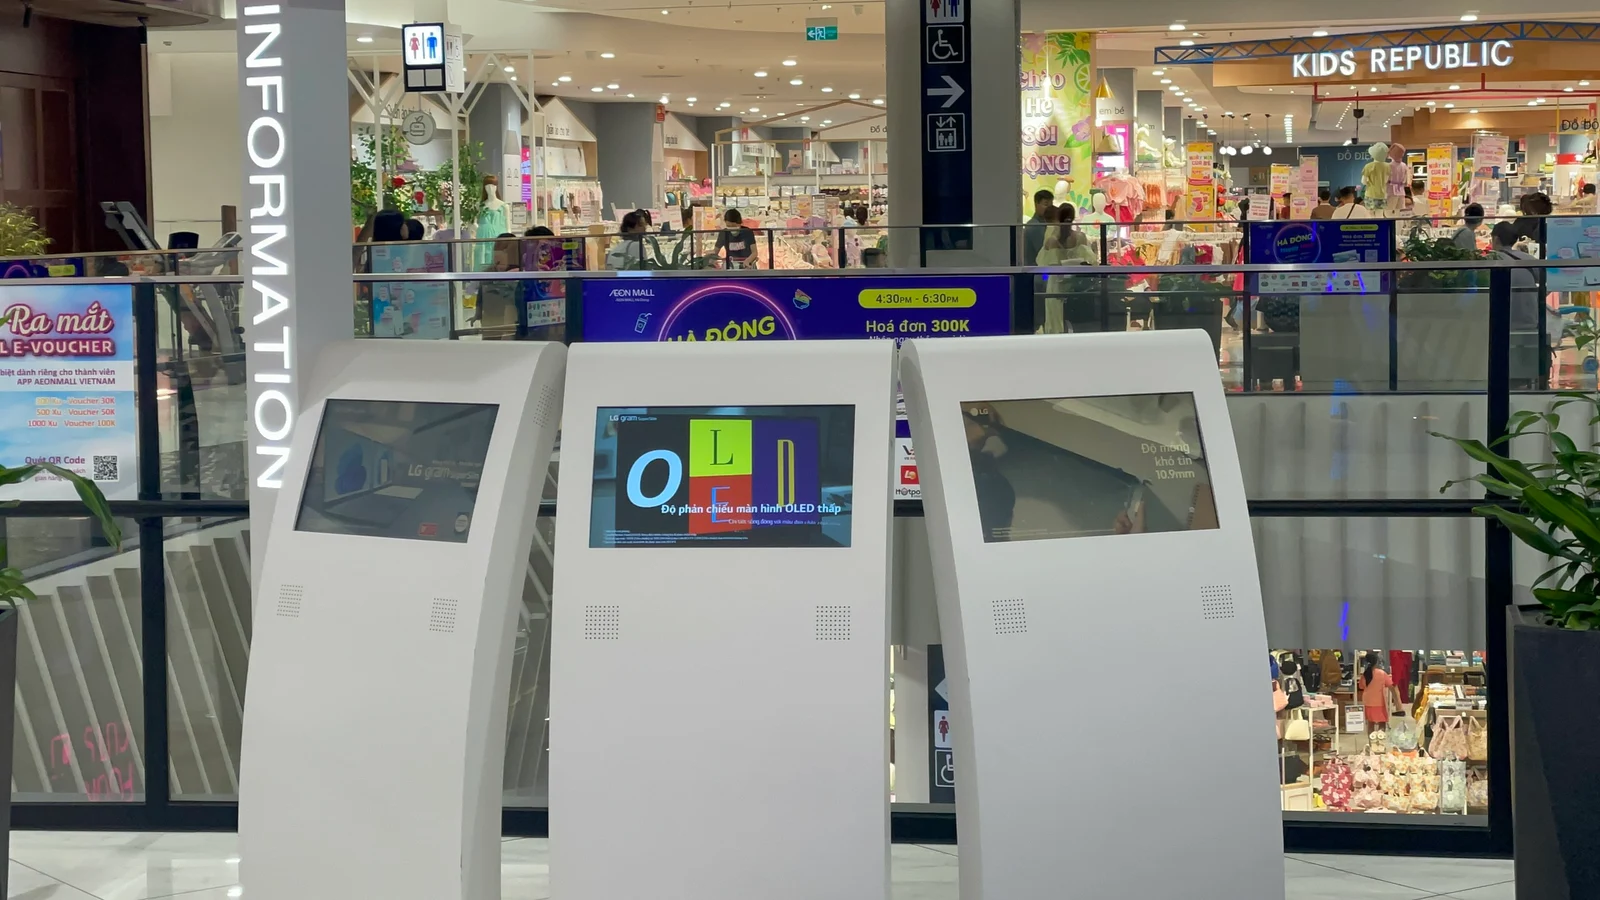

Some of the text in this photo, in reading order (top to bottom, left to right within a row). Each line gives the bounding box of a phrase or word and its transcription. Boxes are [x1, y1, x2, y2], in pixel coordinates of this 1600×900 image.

[1292, 40, 1514, 78] KIDS REPUBLIC
[1114, 106, 1125, 115] bé
[1022, 152, 1071, 179] ỘNG
[243, 4, 292, 490] INFORMATION
[632, 288, 655, 297] MALL
[875, 294, 912, 304] 4:30PM
[922, 293, 959, 303] 6:30PM
[5, 302, 114, 335] Ra mắt
[866, 319, 970, 333] Hoá đơn 300K
[13, 340, 113, 354] E-VOUCHER
[75, 368, 98, 376] thành
[97, 419, 116, 427] 100K
[48, 456, 61, 464] QR
[64, 455, 86, 464] Code
[1154, 456, 1192, 466] khó tin
[407, 464, 423, 477] LG
[1155, 469, 1195, 480] 10.9mm
[626, 449, 683, 508] O
[661, 504, 676, 515] Độ
[706, 503, 733, 513] chiếu
[736, 503, 758, 513] màn
[760, 503, 782, 513] hình
[785, 503, 815, 514] OLED
[817, 503, 841, 515] thấp
